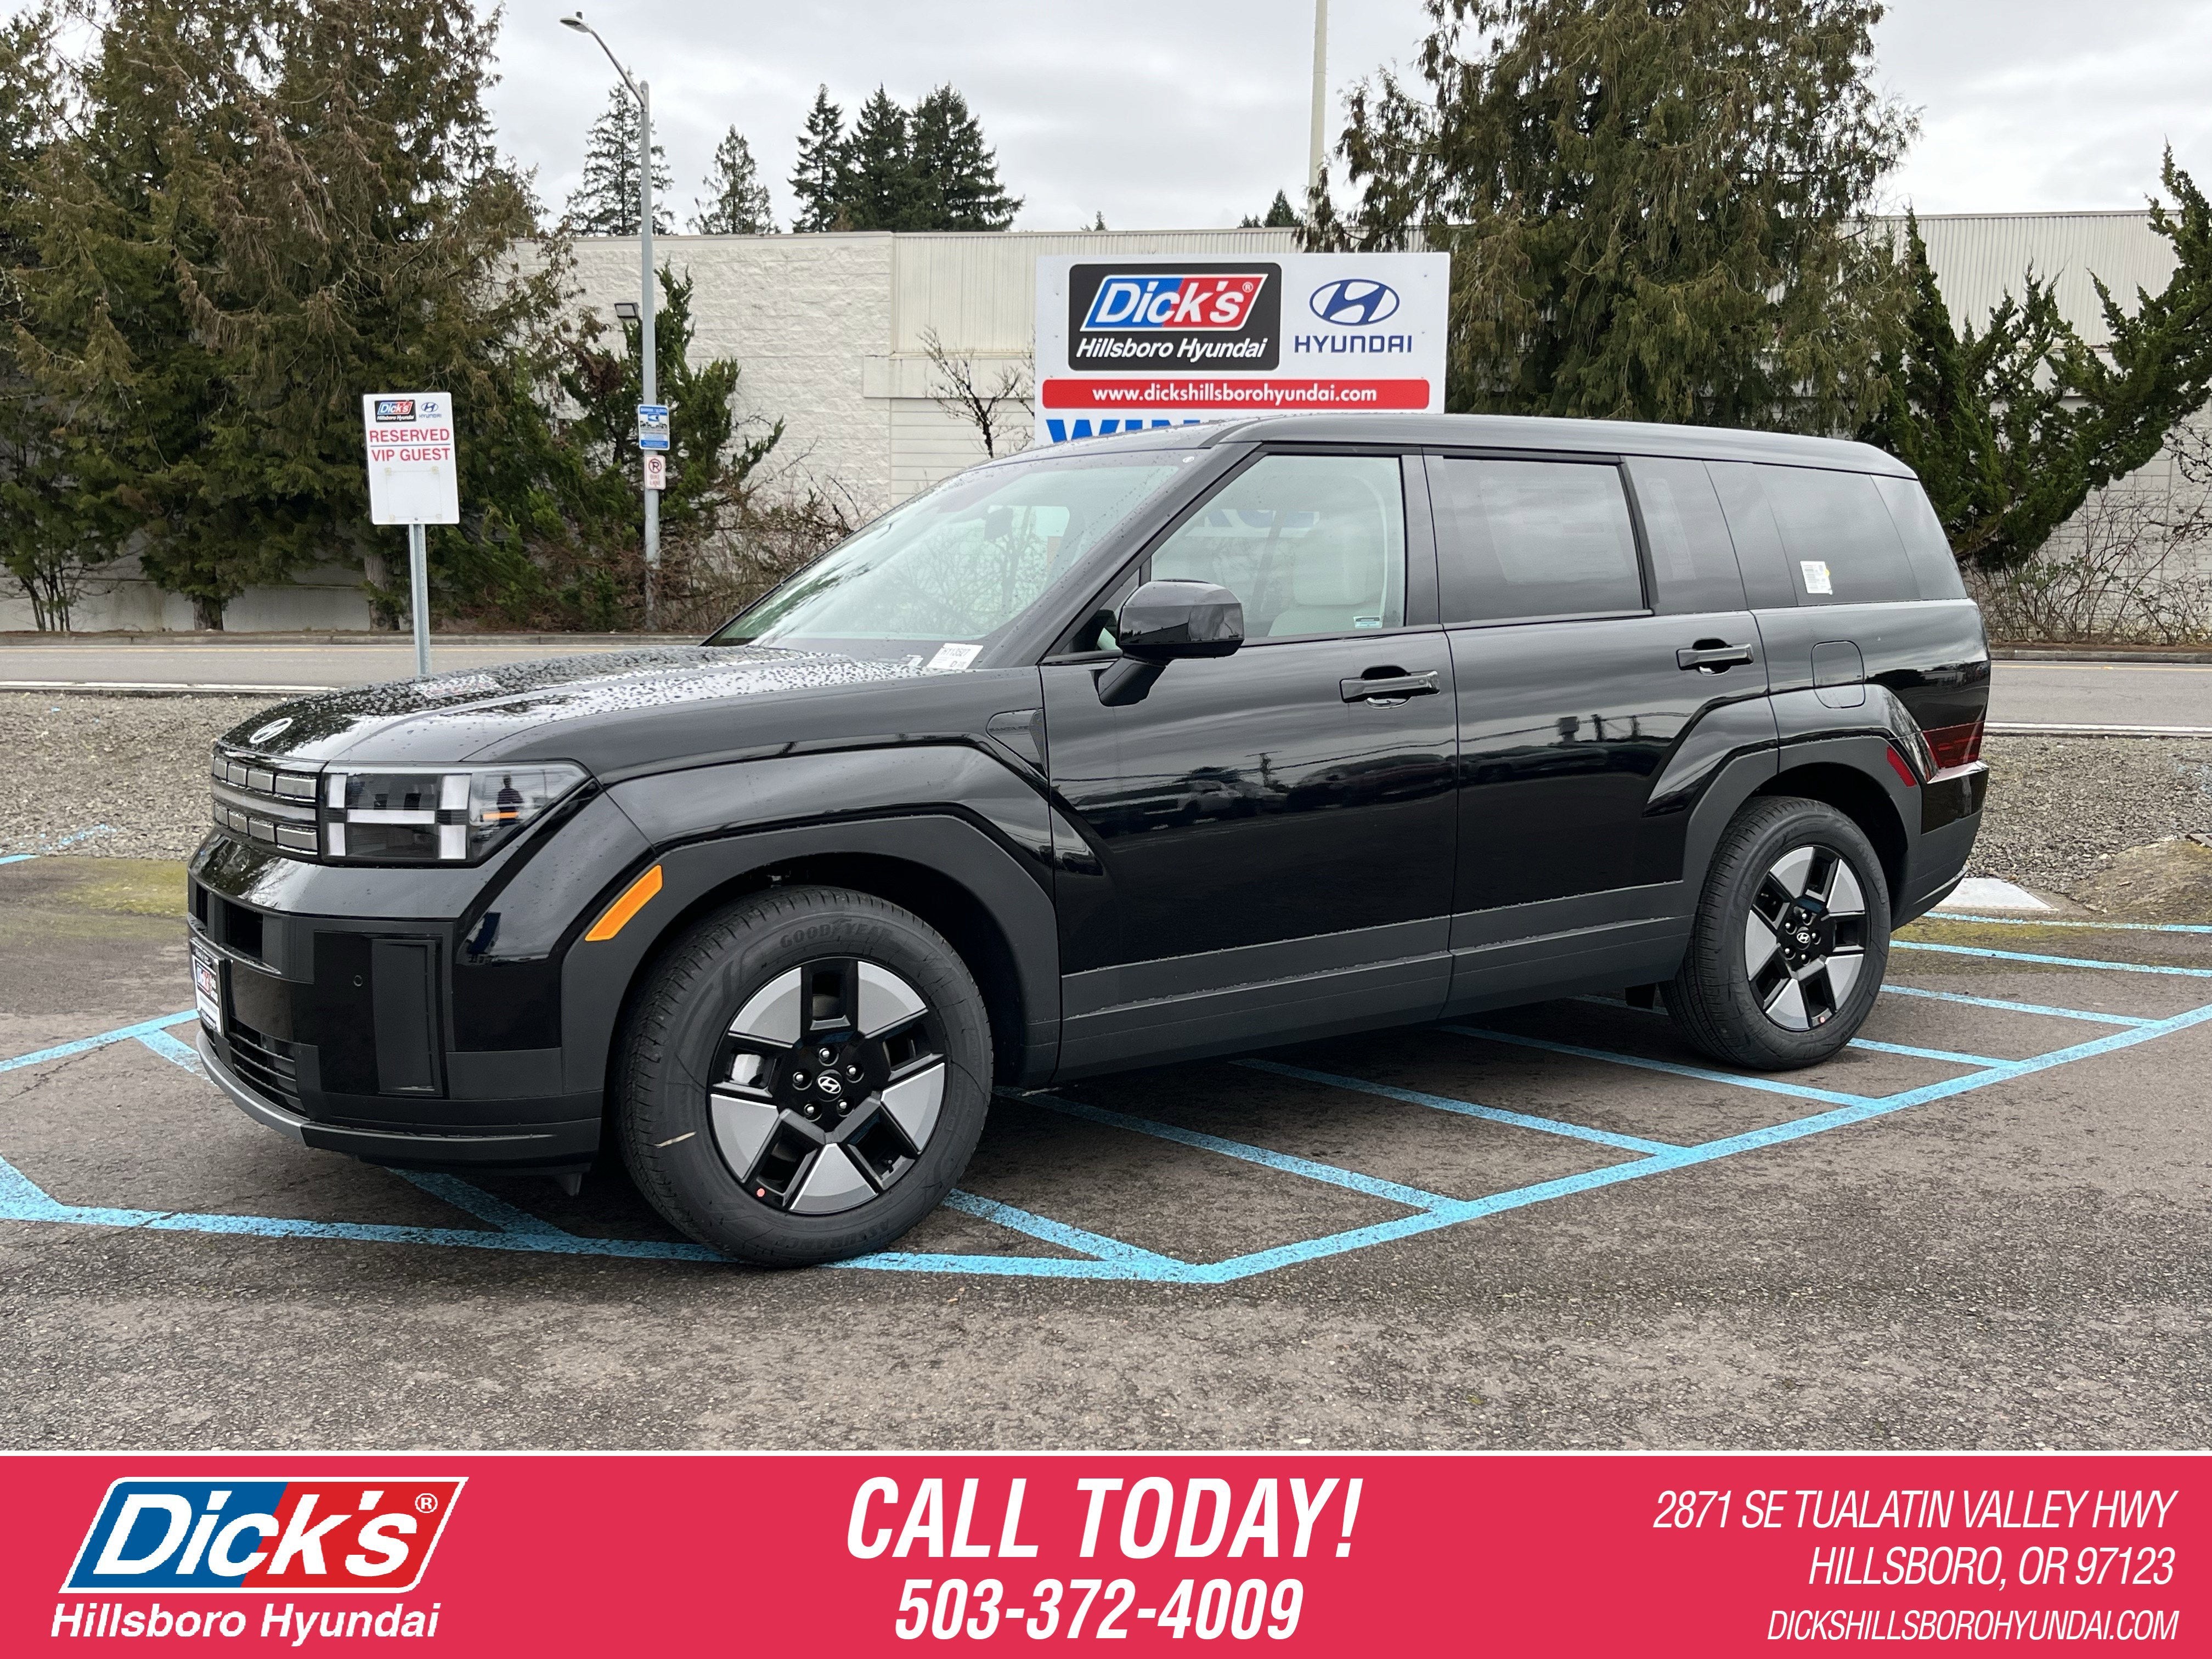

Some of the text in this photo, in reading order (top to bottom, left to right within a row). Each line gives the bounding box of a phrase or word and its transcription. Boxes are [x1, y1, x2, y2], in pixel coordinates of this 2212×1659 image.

[1076, 337, 1268, 363] Hillsboro Hyundai
[1294, 335, 1412, 353] HYUNDAI
[1092, 383, 1377, 407] www.dickshillsborohyundai.com
[369, 428, 450, 442] RESERVED
[371, 447, 450, 462] VIP GUEST
